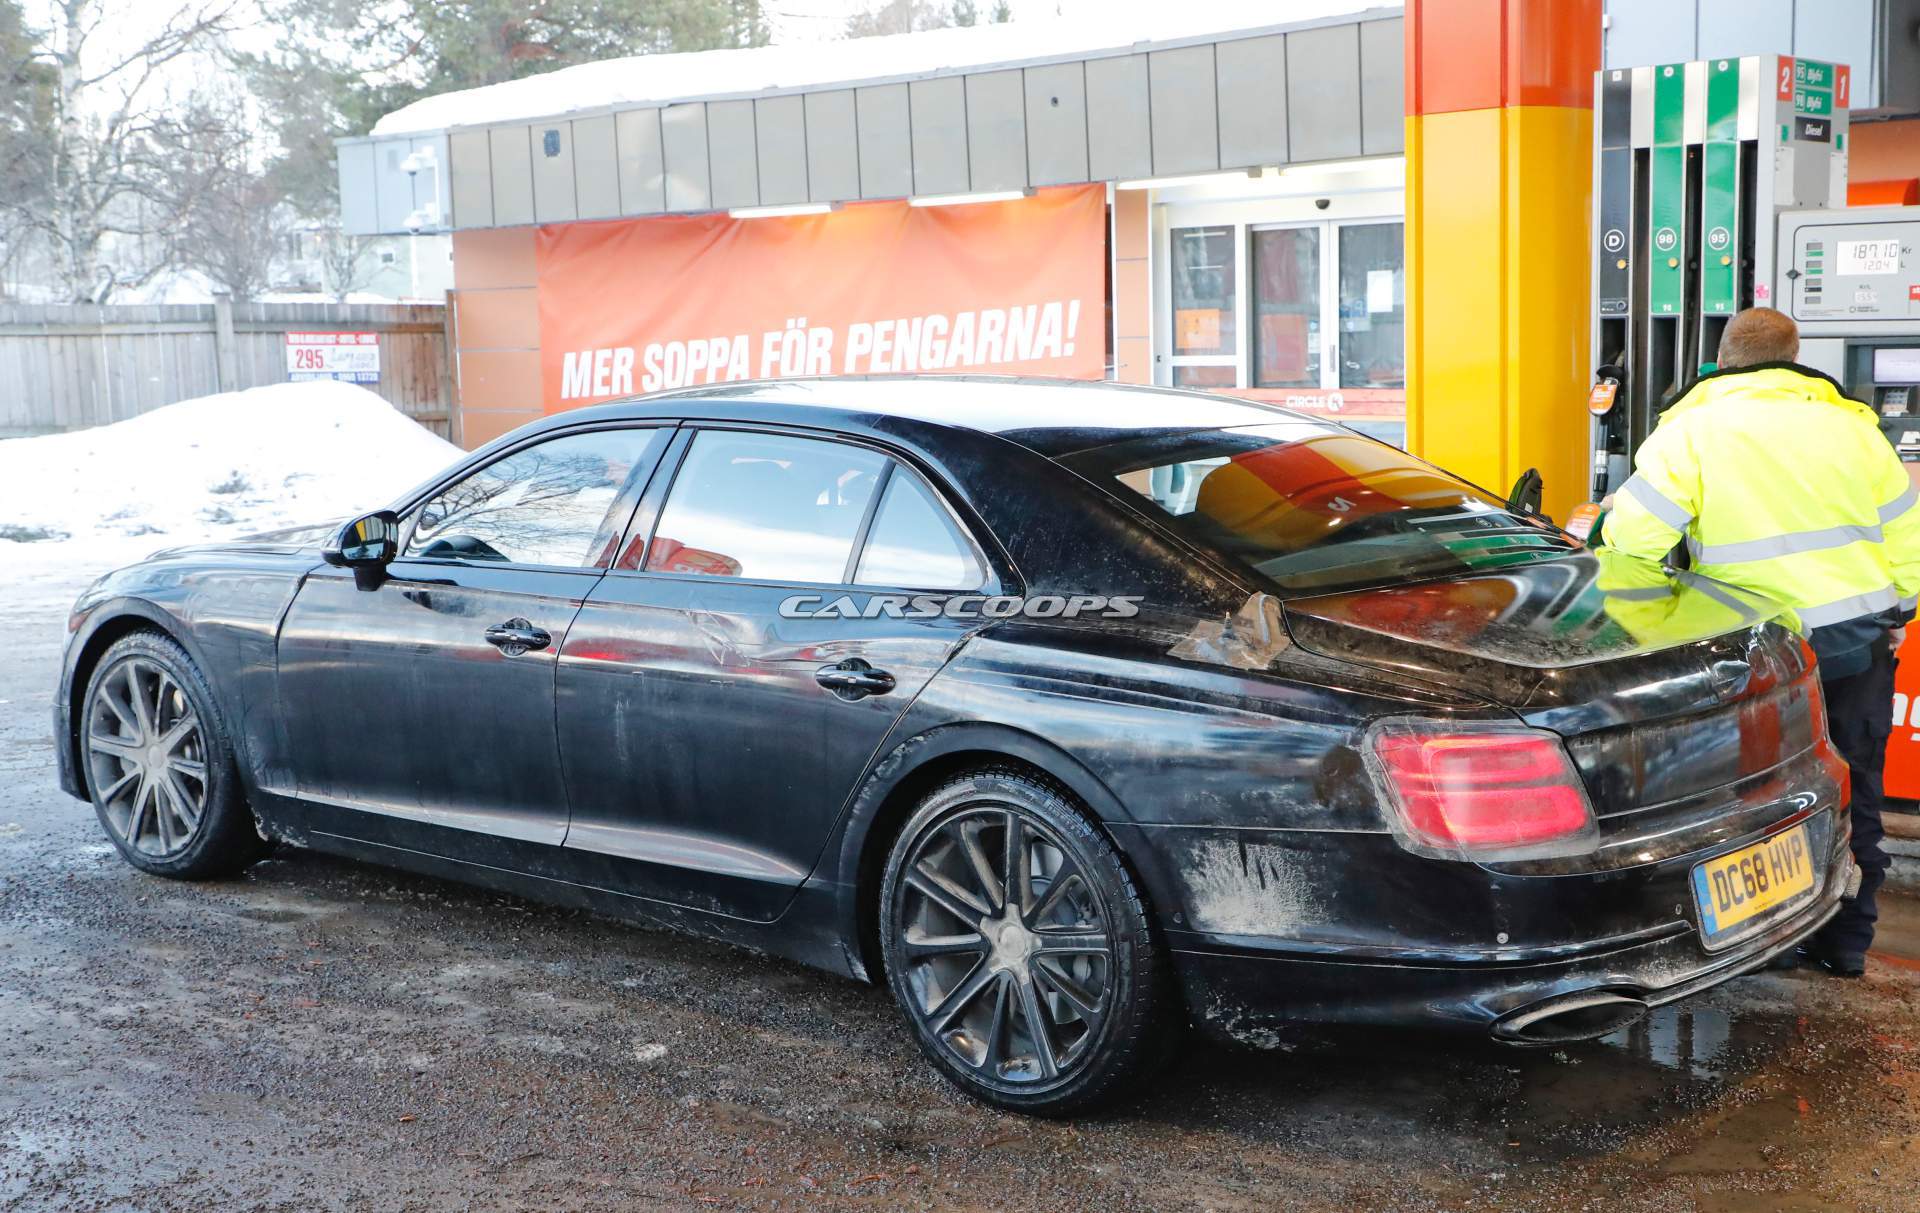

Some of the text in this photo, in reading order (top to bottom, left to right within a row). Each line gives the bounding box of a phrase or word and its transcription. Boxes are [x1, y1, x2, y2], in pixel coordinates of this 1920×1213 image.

[1780, 66, 1790, 93] 2
[1839, 74, 1847, 100] 1
[1805, 124, 1823, 136] Diesel
[1608, 235, 1620, 247] D
[1658, 234, 1673, 244] 98
[1711, 233, 1725, 244] 95
[561, 299, 1081, 399] MER SOPPA FÖR PENGARNA!
[295, 348, 324, 369] 295
[1286, 395, 1326, 408] CIRCLE
[1712, 834, 1803, 912] DC68 HVP
